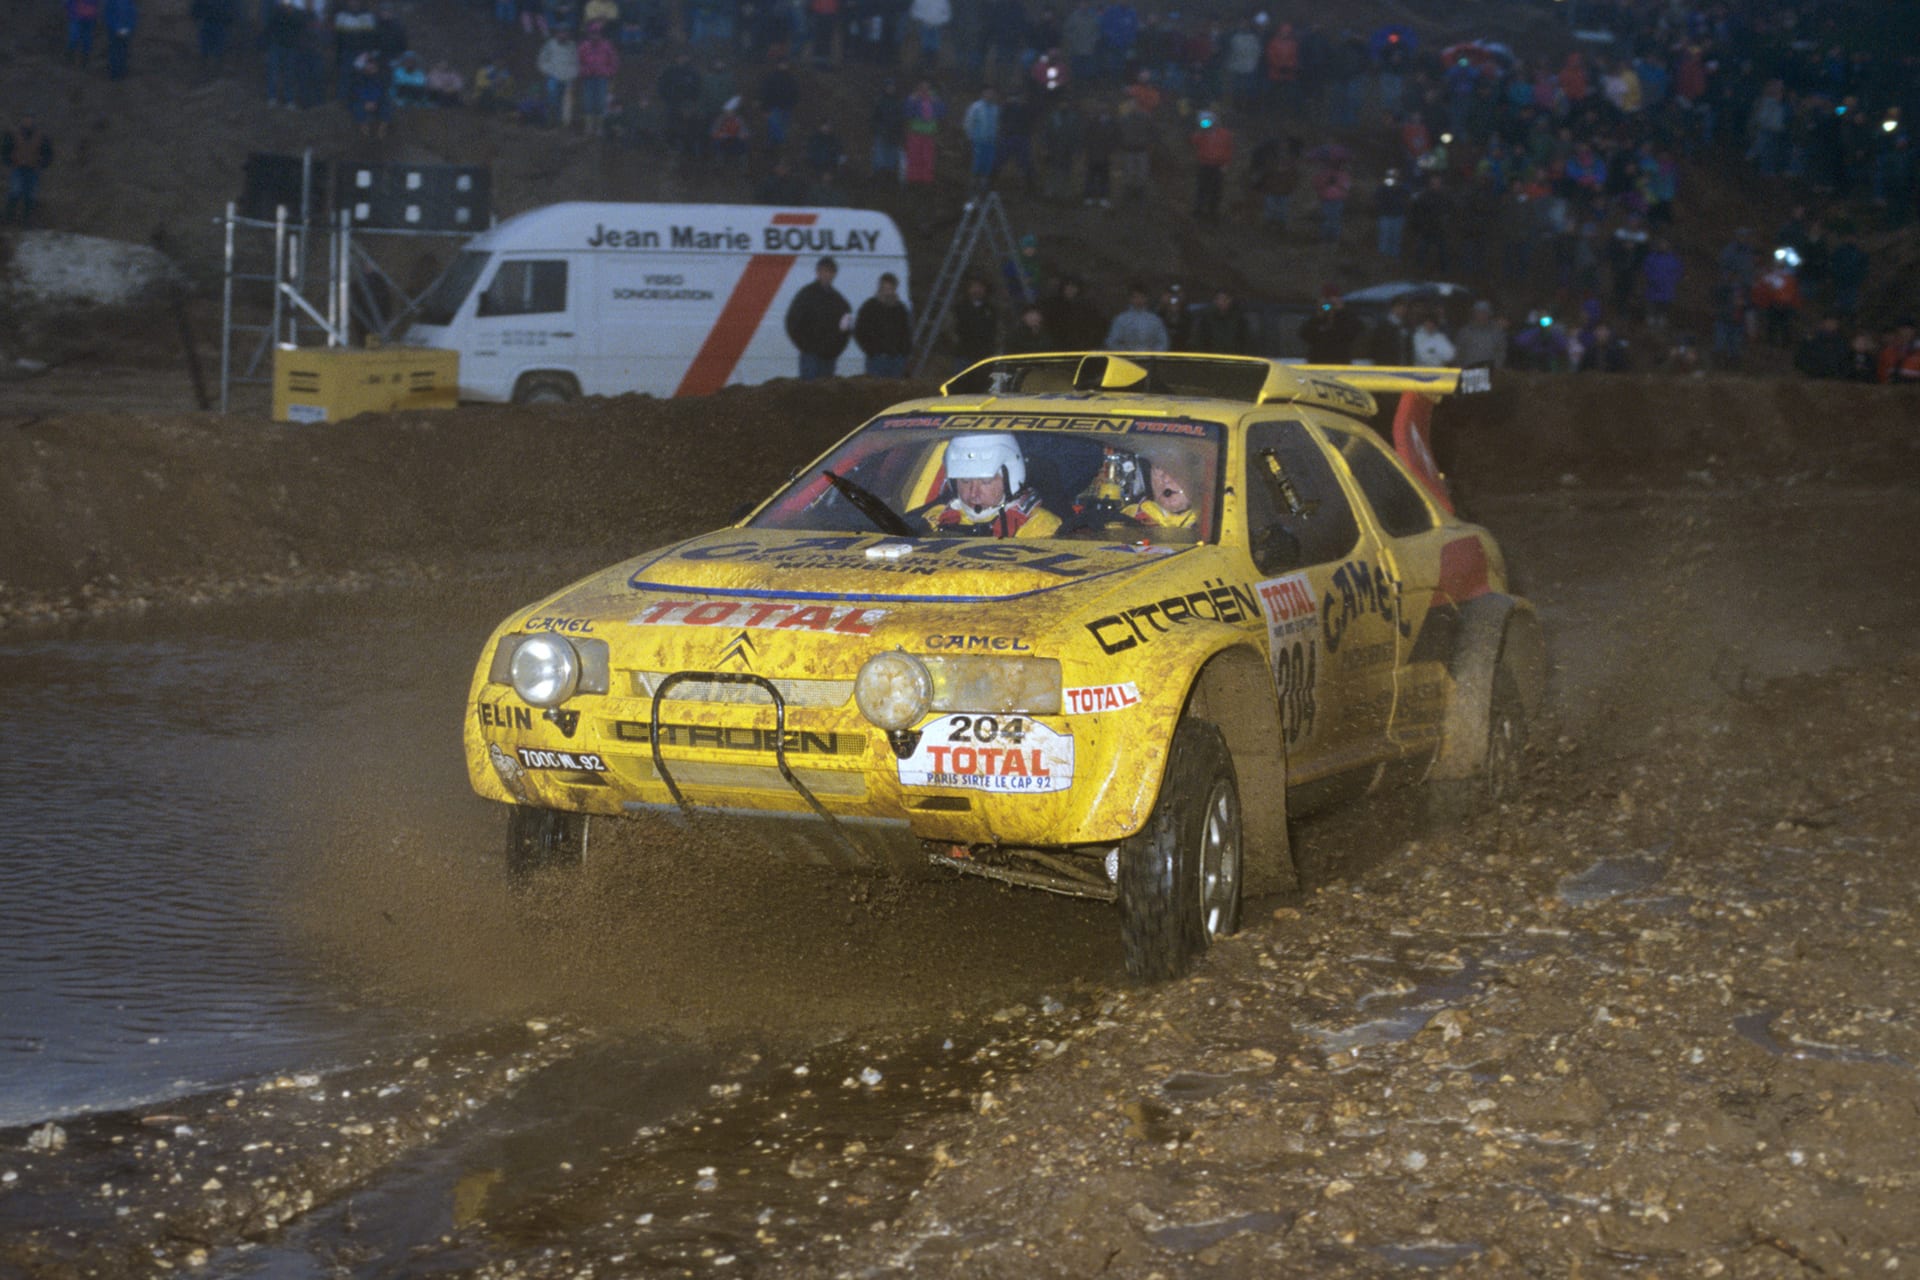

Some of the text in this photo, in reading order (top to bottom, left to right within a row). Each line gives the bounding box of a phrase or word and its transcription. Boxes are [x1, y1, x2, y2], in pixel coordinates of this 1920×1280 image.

[587, 223, 880, 250] Jean Marie BOULAY
[1259, 578, 1316, 624] TOTAL
[525, 617, 594, 633] CAMEL
[643, 600, 878, 635] TOTAL
[924, 633, 1030, 651] CAMEL
[1067, 685, 1138, 713] TOTAL
[948, 715, 1025, 743] 204
[580, 755, 605, 770] 92
[927, 746, 1050, 776] TOTAL
[927, 773, 958, 785] PARIS
[995, 776, 1006, 788] LE
[1011, 776, 1032, 789] CAP
[1036, 777, 1051, 789] 92
